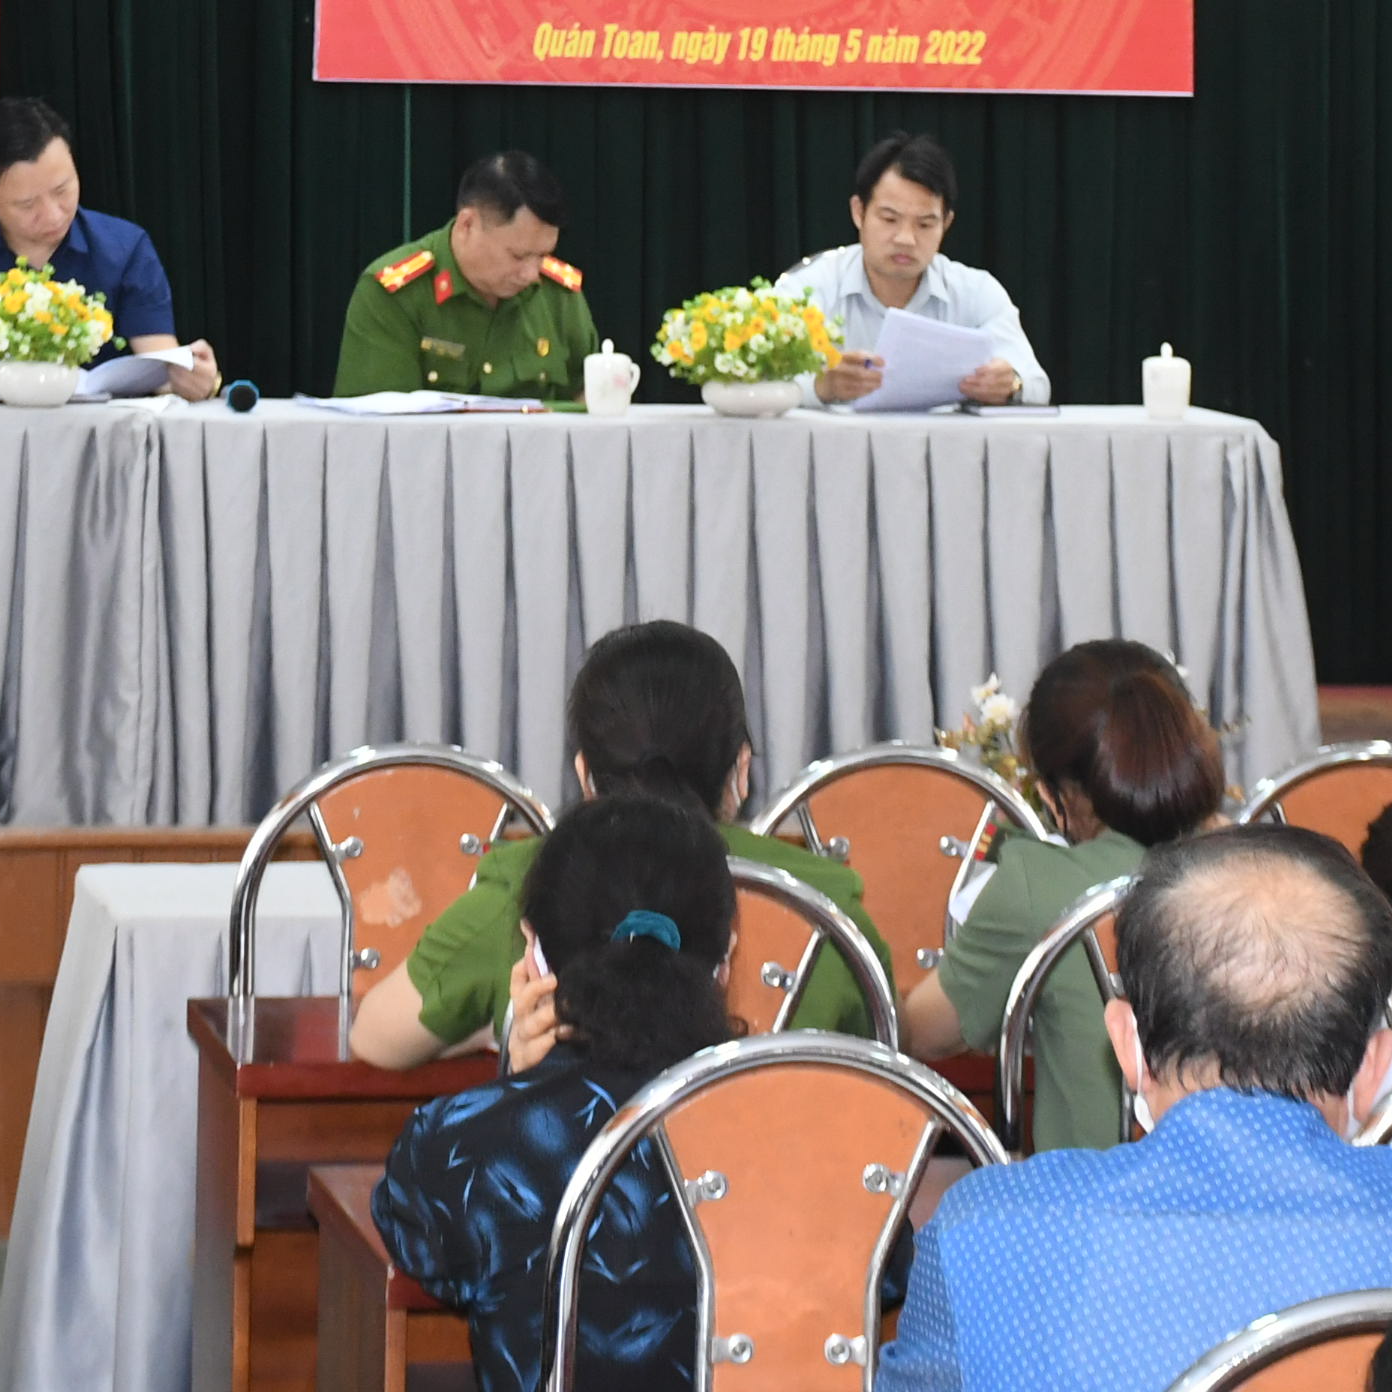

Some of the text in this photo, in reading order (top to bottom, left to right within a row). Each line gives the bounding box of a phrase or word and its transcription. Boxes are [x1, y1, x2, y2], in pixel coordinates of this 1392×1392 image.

[533, 22, 987, 68] Quán Toan, ngày 19 tháng 5 năm 2022
